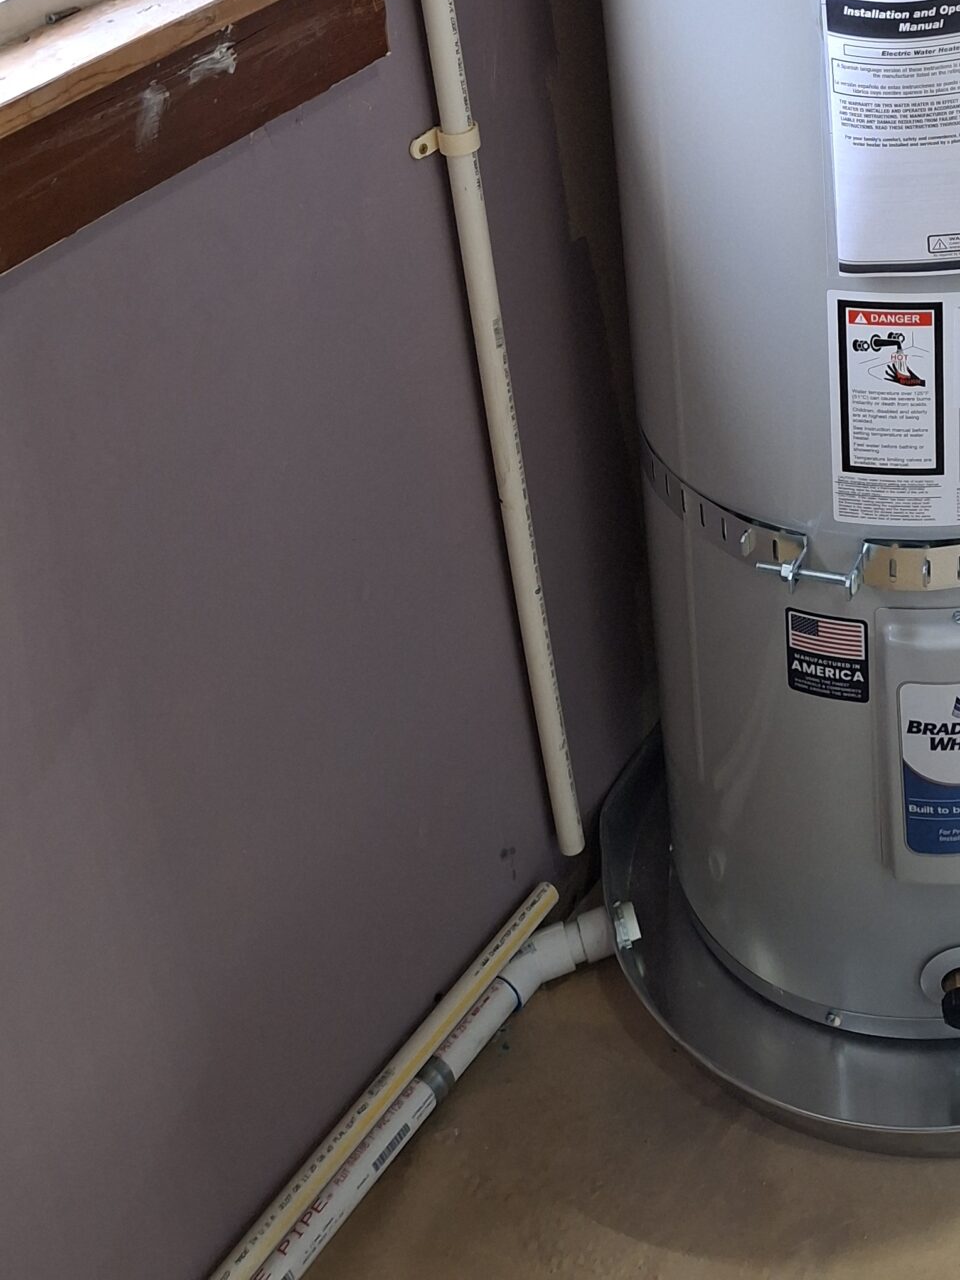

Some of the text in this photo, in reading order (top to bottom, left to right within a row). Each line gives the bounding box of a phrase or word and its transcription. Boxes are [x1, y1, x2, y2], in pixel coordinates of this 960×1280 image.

[843, 5, 910, 20] Installation
[912, 7, 937, 19] and
[898, 19, 945, 32] Manual
[913, 47, 937, 56] Water
[870, 314, 921, 324] DANGER
[794, 652, 851, 668] MANUFACTURED
[791, 660, 865, 682] AMERICA
[908, 804, 935, 815] Built
[937, 806, 949, 814] to
[938, 828, 952, 836] For
[275, 1195, 329, 1257] PIPE
